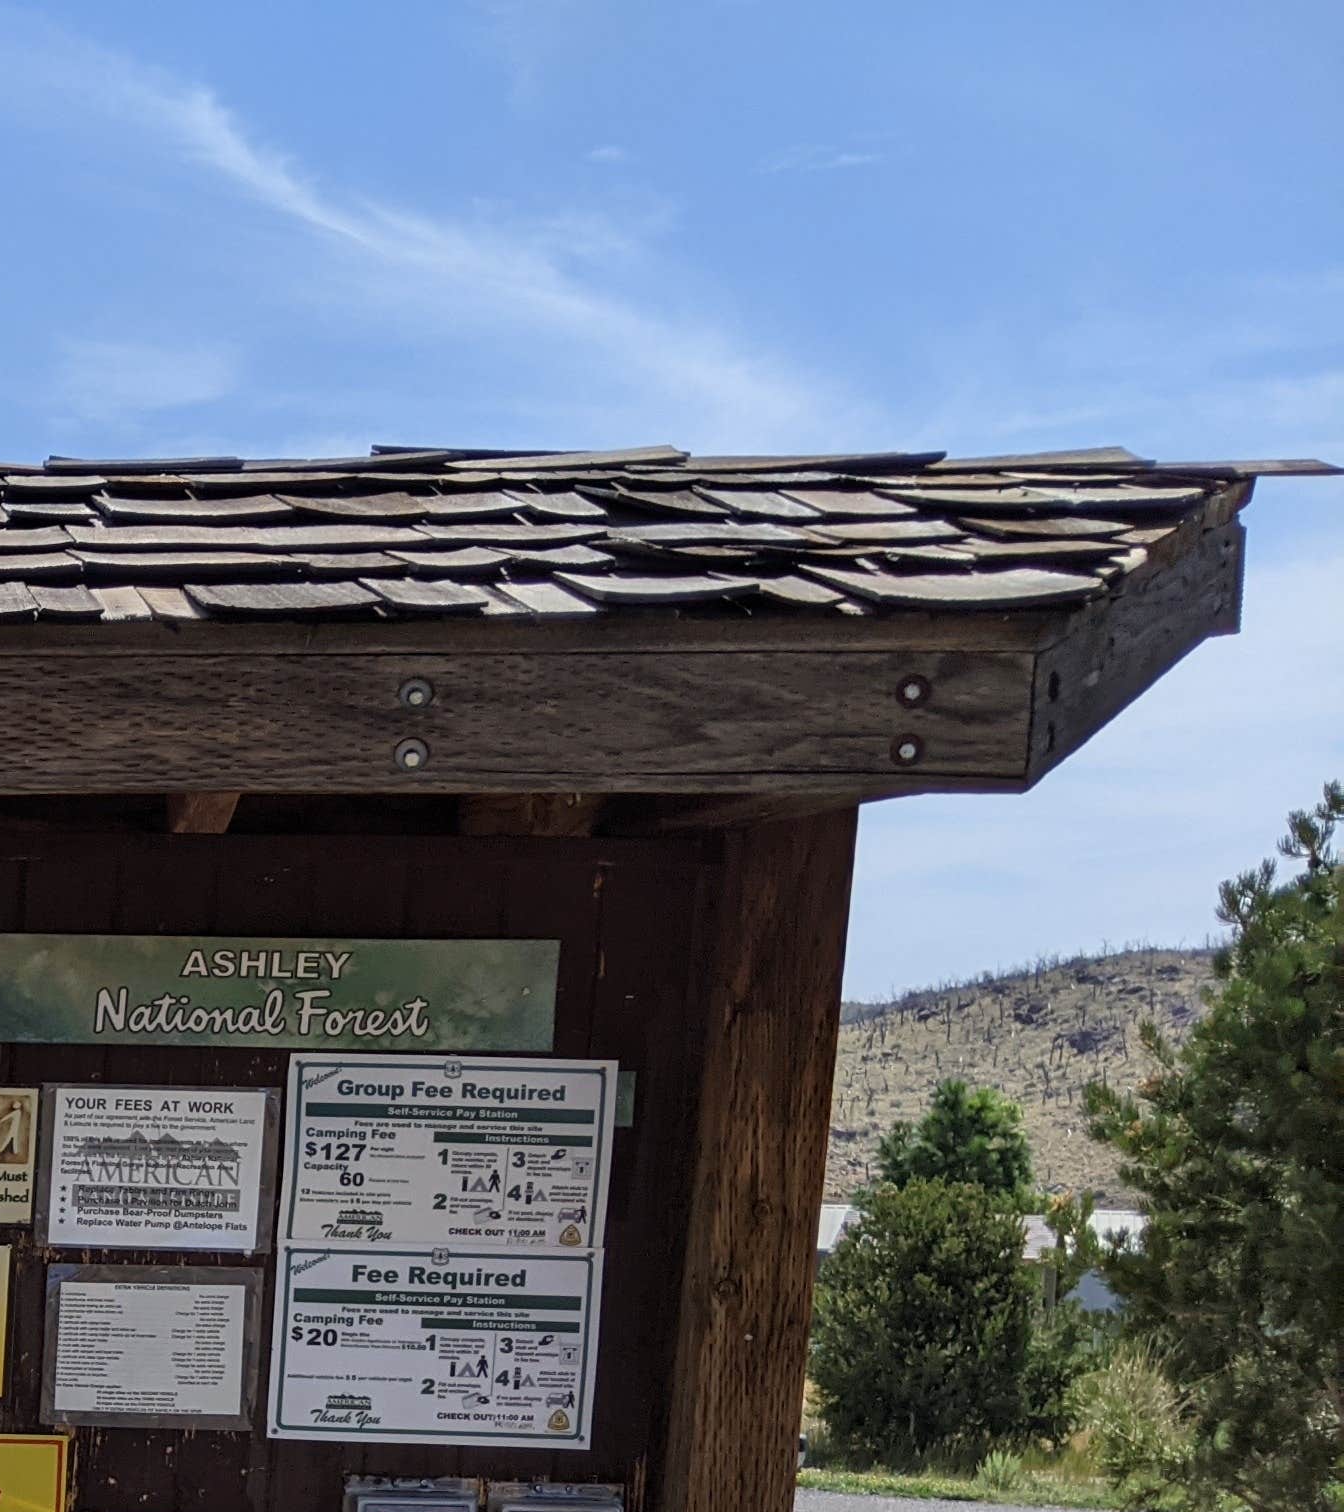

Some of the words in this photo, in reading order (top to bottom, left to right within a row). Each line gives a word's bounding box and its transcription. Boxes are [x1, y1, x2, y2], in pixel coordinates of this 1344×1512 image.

[181, 950, 352, 980] ASHLEY
[93, 987, 288, 1037] National
[296, 989, 430, 1038] Forest
[337, 1079, 405, 1100] Group
[412, 1081, 452, 1098] Fee
[463, 1083, 566, 1102] Required
[65, 1097, 106, 1110] YOUR
[115, 1099, 152, 1111] FEES
[161, 1100, 181, 1112] AT
[188, 1101, 235, 1114] WORK
[387, 1106, 452, 1118] Self-Service
[456, 1109, 477, 1119] Pay
[480, 1109, 518, 1119] Station
[306, 1128, 367, 1140] Camping
[372, 1129, 396, 1139] Fee
[485, 1135, 550, 1143] Instructions
[305, 1142, 367, 1161] $127
[437, 1149, 449, 1165] 1
[512, 1151, 525, 1168] 3
[304, 1162, 349, 1172] Capacity
[340, 1172, 364, 1187] 60
[507, 1185, 522, 1201] 4
[433, 1193, 447, 1210] 2
[77, 1207, 120, 1216] Purchase
[122, 1208, 171, 1217] Bear-Proof
[174, 1210, 223, 1220] Dumpsters
[76, 1217, 113, 1227] Replace
[115, 1219, 142, 1228] Water
[145, 1220, 170, 1230] Pump
[225, 1222, 247, 1231] Flats
[448, 1228, 482, 1236] CHECK
[321, 1224, 362, 1238] Thank
[366, 1226, 393, 1242] You
[352, 1264, 399, 1283] Fee
[408, 1266, 527, 1290] Required
[375, 1292, 440, 1305] Self-Service
[443, 1295, 465, 1307] Pay
[467, 1296, 506, 1306] Station
[293, 1313, 354, 1326] Camping
[359, 1315, 384, 1325] Fee
[473, 1321, 536, 1330] Instructions
[425, 1334, 436, 1351] 1
[499, 1337, 514, 1353] 3
[421, 1378, 435, 1394] 2
[495, 1370, 510, 1386] 4
[310, 1409, 352, 1423] Thank
[355, 1410, 382, 1430] You
[437, 1412, 471, 1420] CHECK
